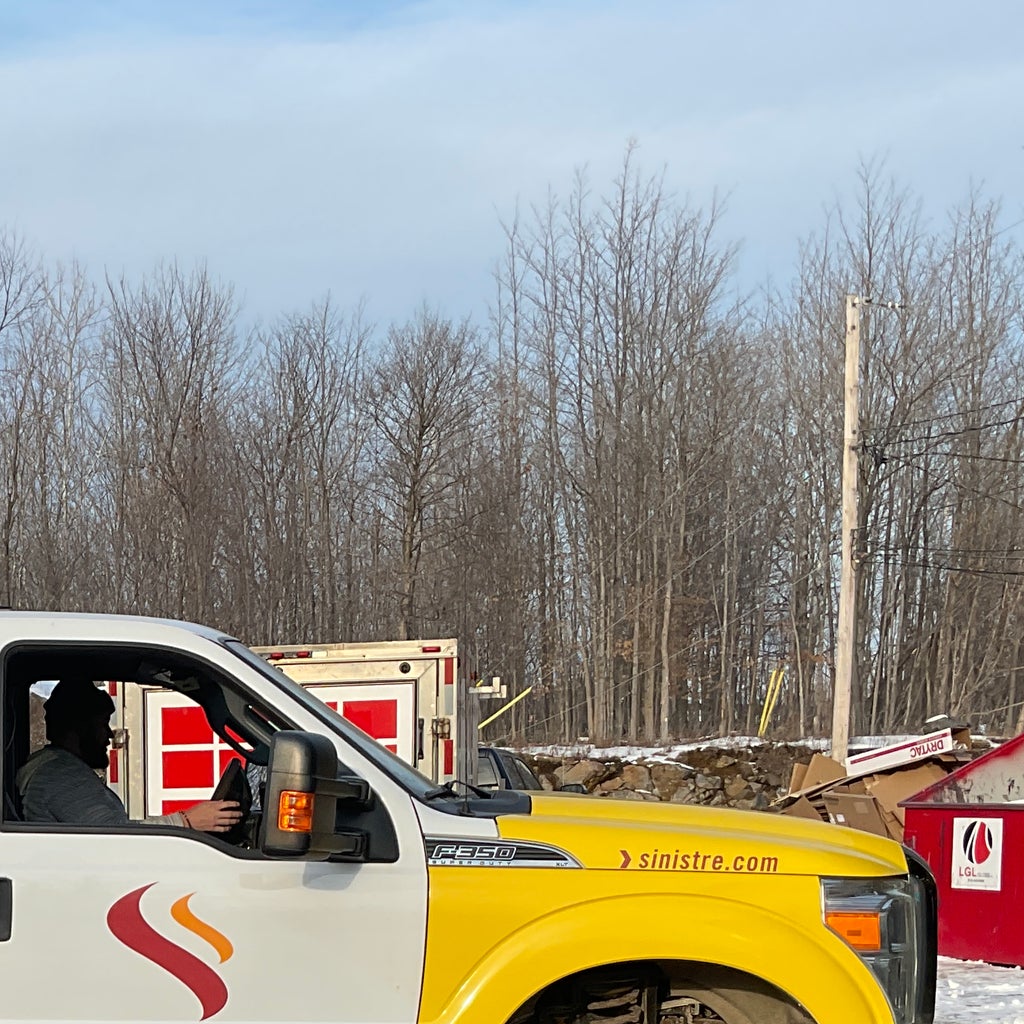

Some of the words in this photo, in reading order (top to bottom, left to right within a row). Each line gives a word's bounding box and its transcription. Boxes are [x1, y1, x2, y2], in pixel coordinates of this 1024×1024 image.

[909, 739, 944, 758] DRYTAC
[638, 849, 779, 872] sinistre.com
[959, 866, 977, 877] LGL
